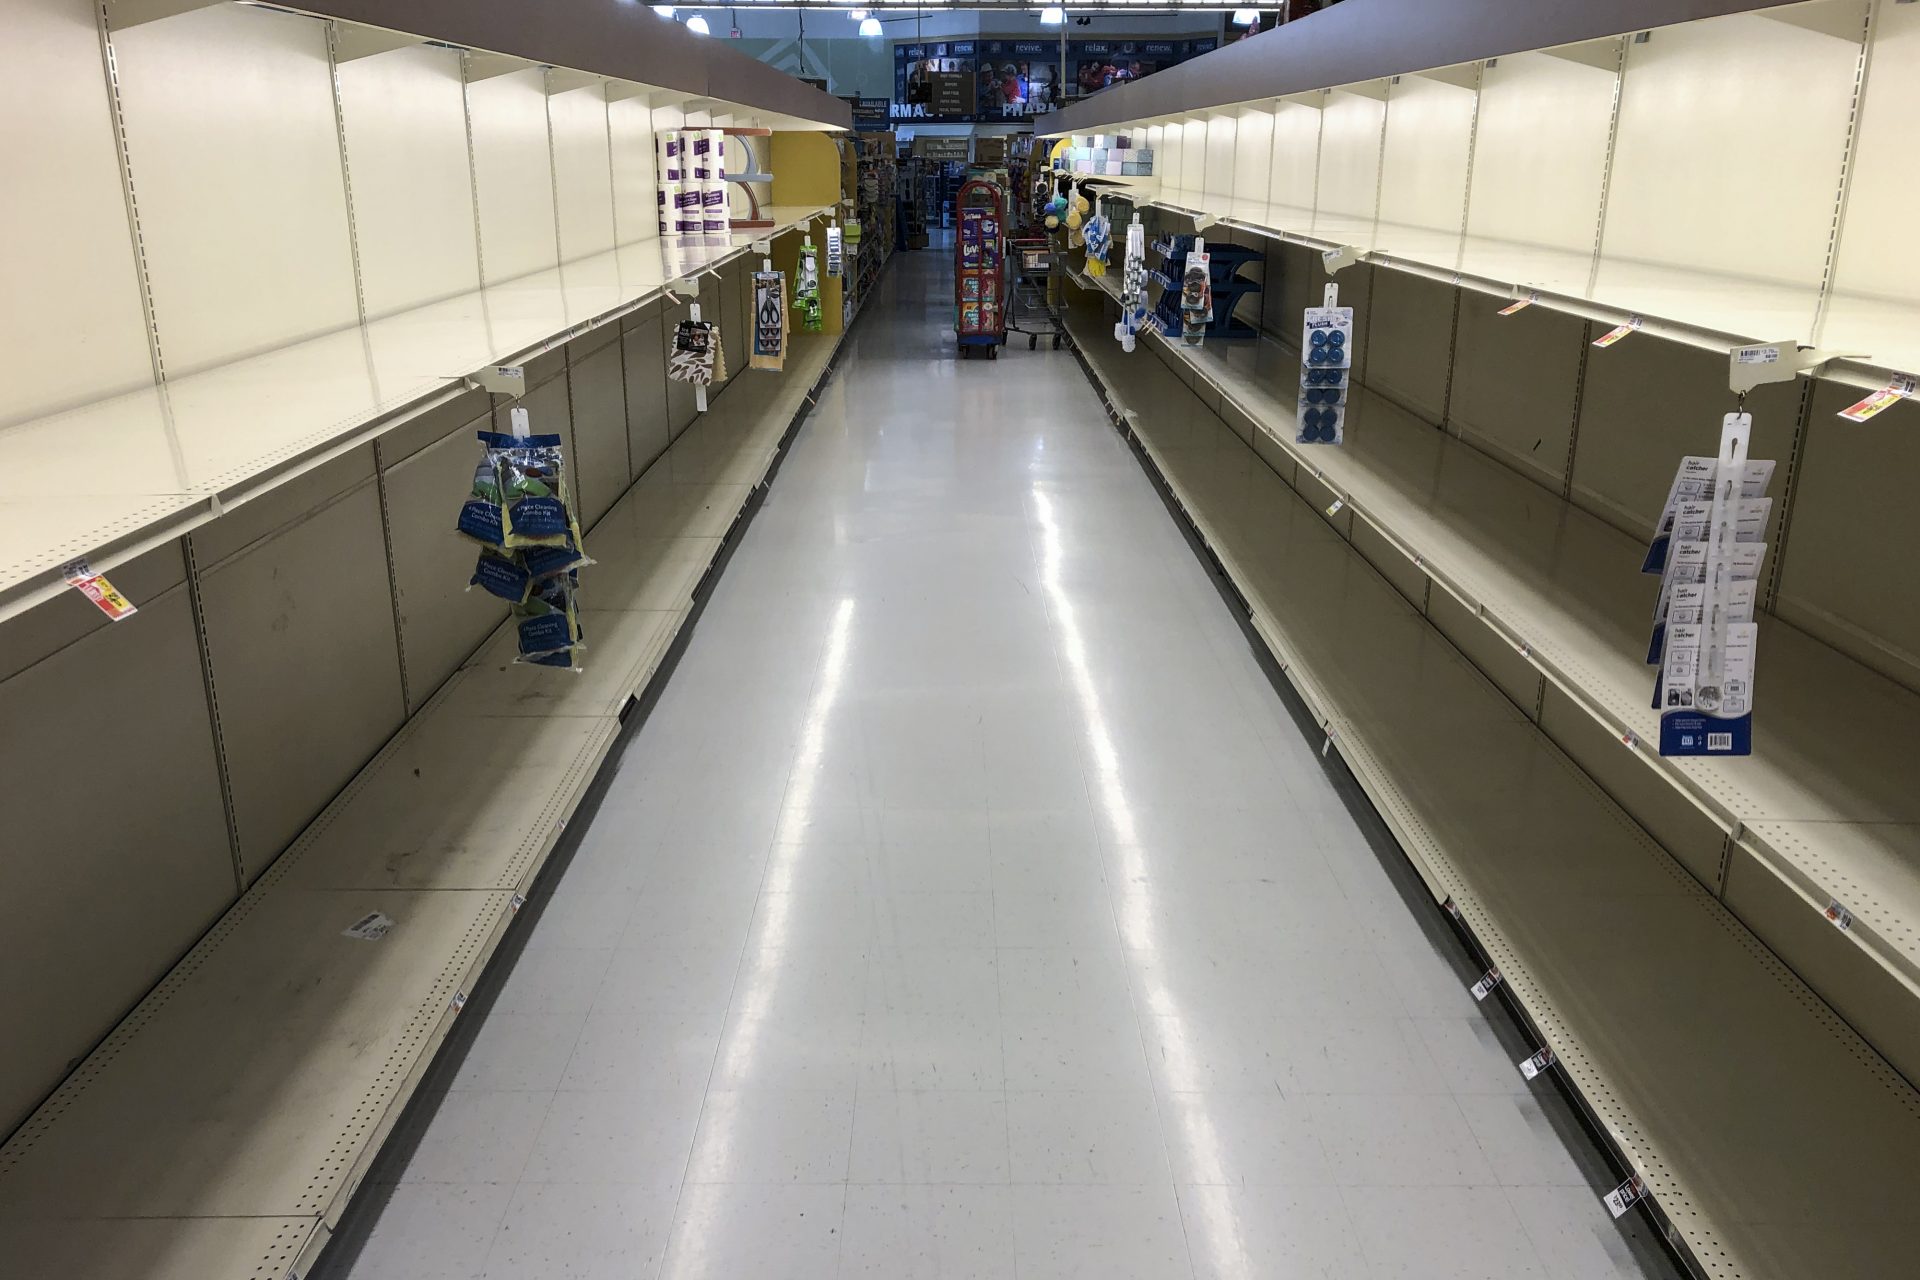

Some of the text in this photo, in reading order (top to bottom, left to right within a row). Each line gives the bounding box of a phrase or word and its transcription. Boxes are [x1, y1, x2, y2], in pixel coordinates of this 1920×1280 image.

[1015, 43, 1042, 53] revive.
[1084, 43, 1108, 52] relax.
[1145, 44, 1171, 52] renew.
